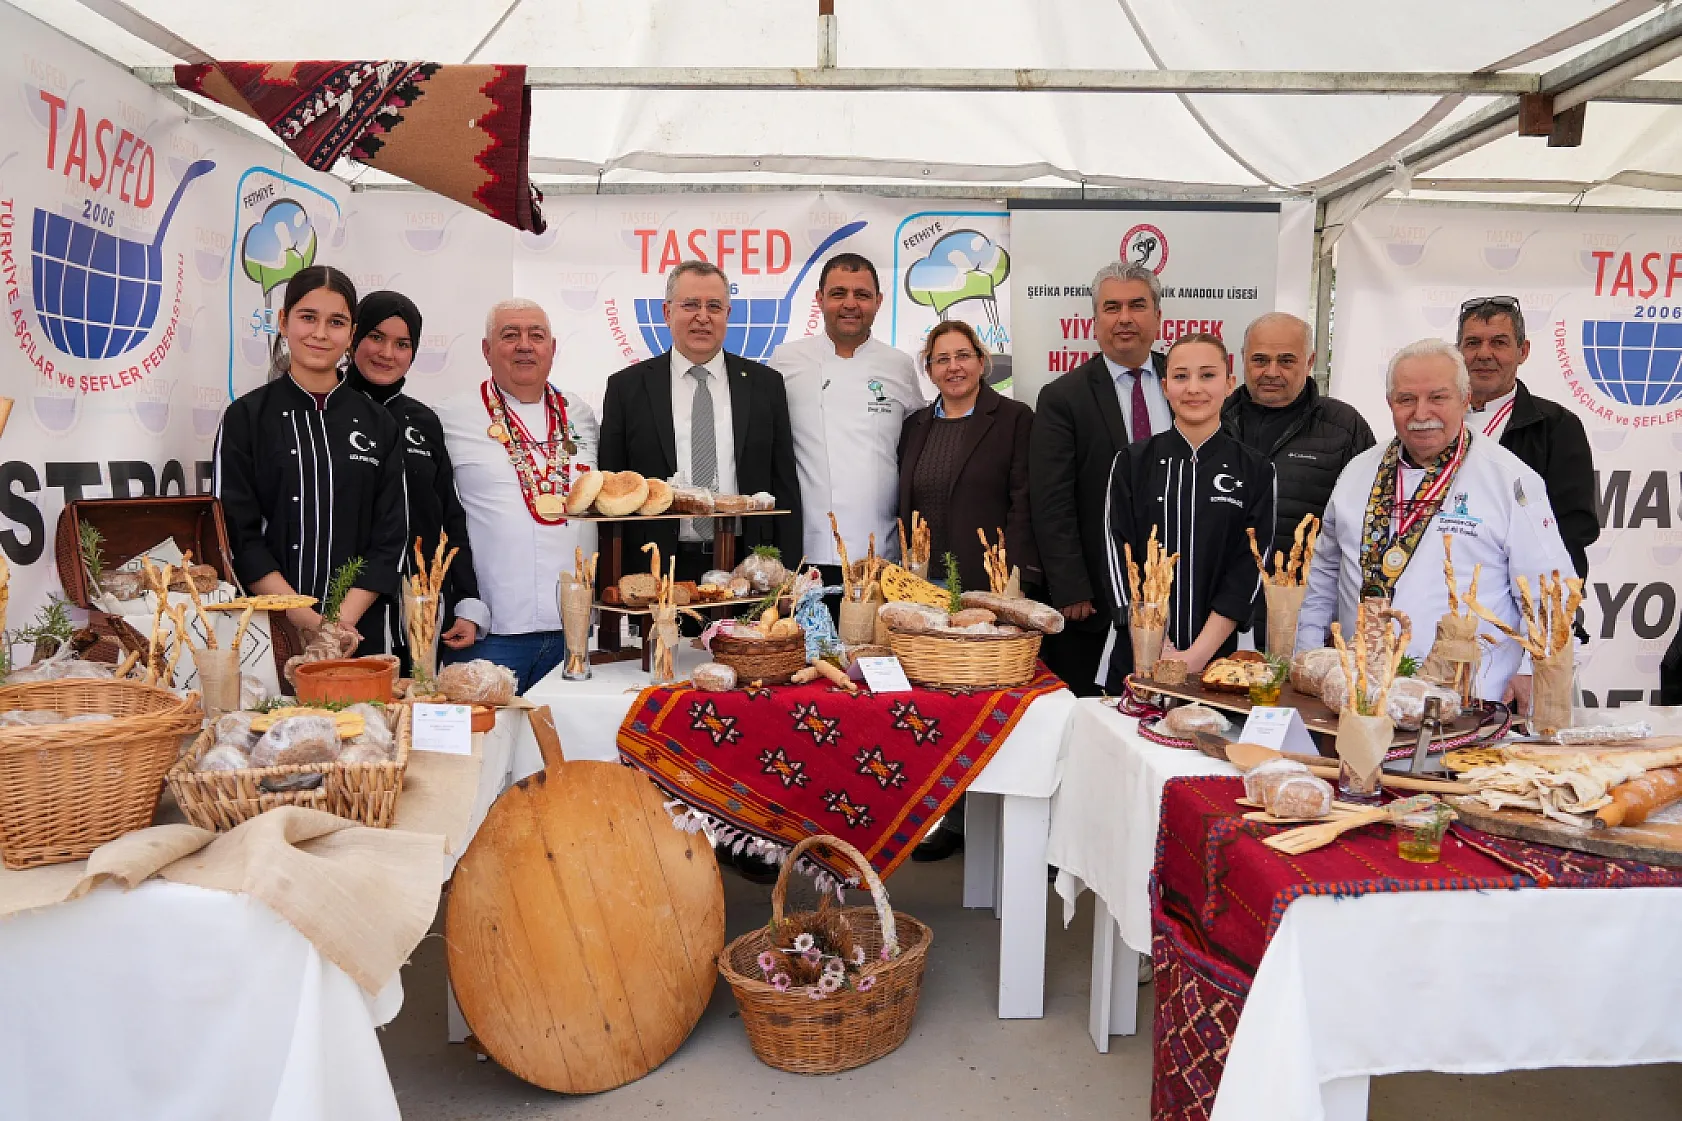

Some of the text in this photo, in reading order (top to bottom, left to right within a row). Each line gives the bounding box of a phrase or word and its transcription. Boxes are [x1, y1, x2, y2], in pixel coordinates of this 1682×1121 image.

[82, 198, 115, 228] 2006
[0, 198, 20, 305] TÜRKİYE
[11, 308, 55, 379] AŞÇILAR
[59, 372, 75, 388] ve
[80, 366, 143, 395] ŞEFLER
[1027, 284, 1060, 299] ŞEFİKA
[1178, 286, 1224, 299] ANADOLU
[1227, 286, 1258, 299] LİSESİ
[1060, 313, 1098, 340] YİY
[1634, 305, 1682, 320] 2006
[604, 299, 634, 356] TÜRKİYE
[1554, 319, 1574, 379] TÜRKİYE
[1569, 380, 1614, 421] AŞÇILAR
[1616, 415, 1629, 426] ve
